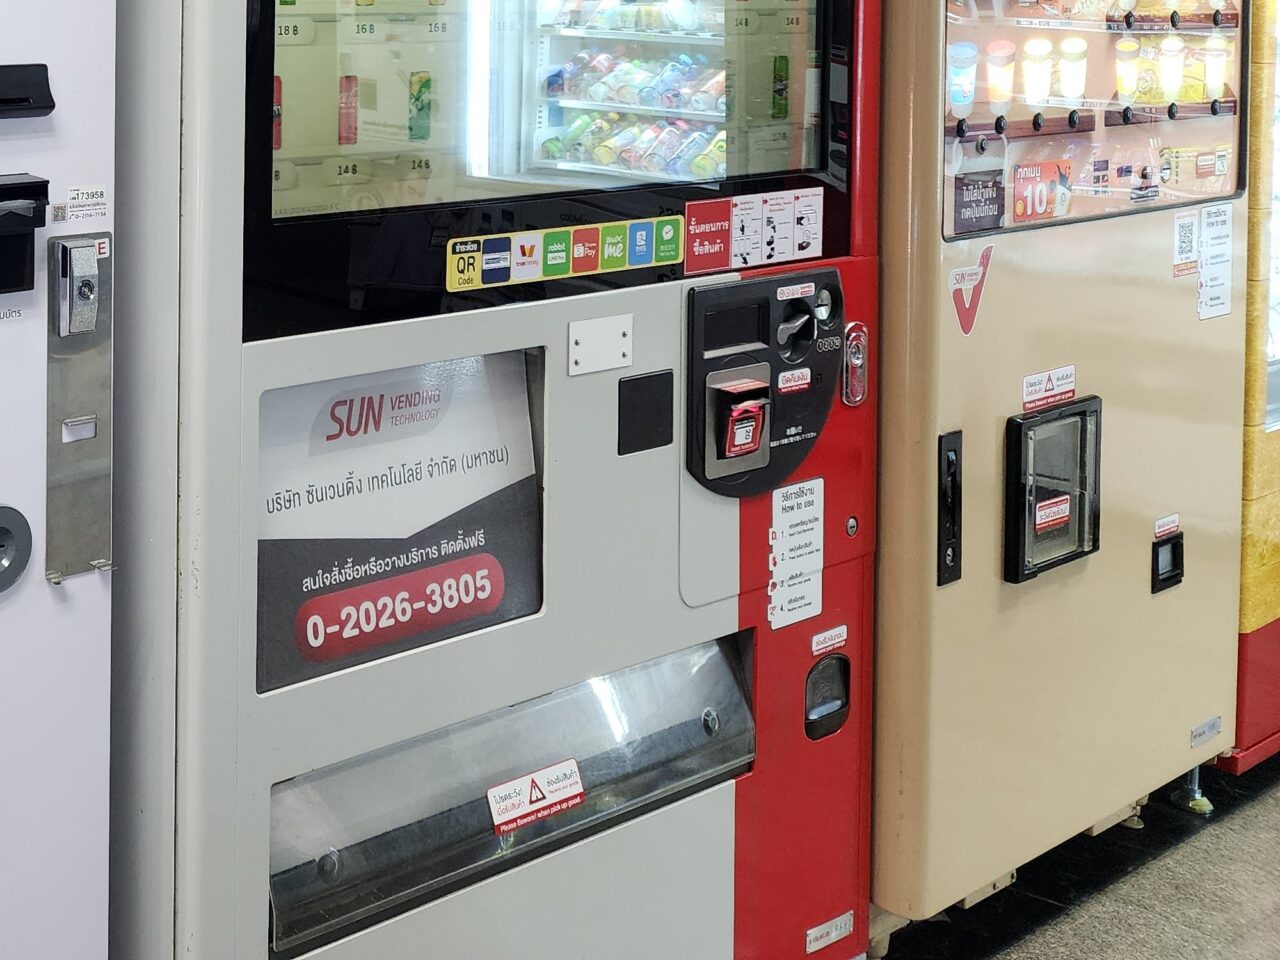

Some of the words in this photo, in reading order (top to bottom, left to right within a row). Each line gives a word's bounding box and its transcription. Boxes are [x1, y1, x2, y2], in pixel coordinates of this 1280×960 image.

[278, 26, 290, 36] 18
[355, 24, 367, 33] 16
[428, 23, 440, 33] 16
[337, 165, 349, 175] 14
[1017, 165, 1041, 183] ทุกเมนู
[76, 191, 104, 200] 173958
[1024, 182, 1048, 216] 10
[98, 241, 107, 255] E
[548, 242, 566, 251] rabbit
[584, 247, 596, 258] Pay
[456, 255, 476, 274] QR
[458, 276, 474, 286] Code
[326, 393, 384, 441] SUN
[390, 388, 440, 411] VENDING
[390, 408, 440, 426] TECHNOLOGY
[266, 489, 301, 514] บริษัท
[306, 471, 363, 505] ซันเวนดิ้ง
[367, 460, 422, 492] เทคโนโลยี
[427, 456, 457, 478] จำกัด
[462, 445, 509, 475] (มหาชน)
[781, 503, 795, 515] How
[796, 501, 802, 511] to
[804, 499, 815, 508] use
[302, 545, 438, 592] สนใจสั่งซื้อหรือวางบริการ
[440, 529, 486, 556] ติดตั้งฟรี
[306, 568, 491, 648] 0-2026-3805
[500, 822, 517, 833] Please
[517, 814, 537, 827] Beware!
[537, 809, 550, 818] when
[550, 804, 560, 815] pick
[561, 802, 568, 810] up
